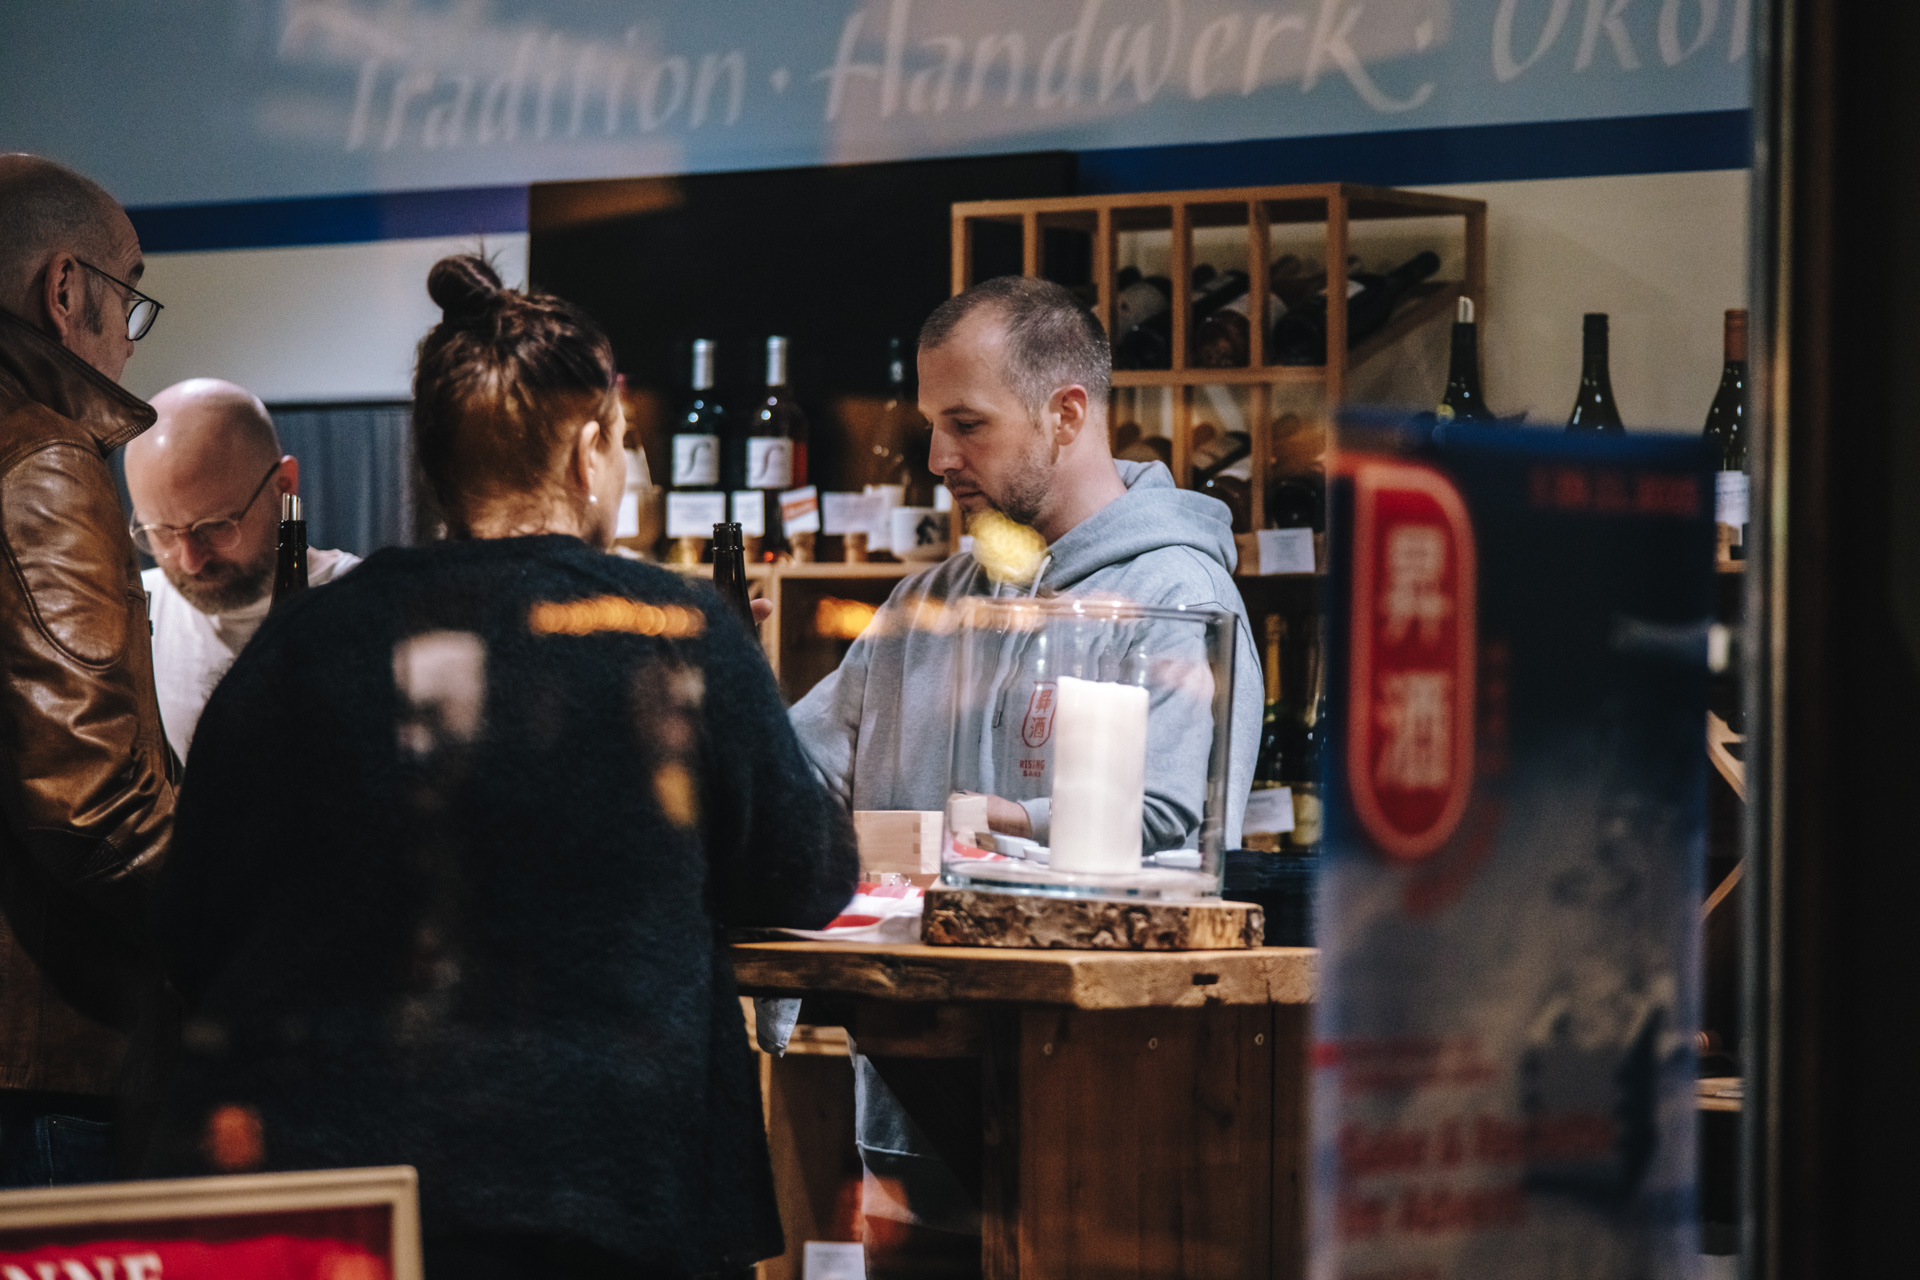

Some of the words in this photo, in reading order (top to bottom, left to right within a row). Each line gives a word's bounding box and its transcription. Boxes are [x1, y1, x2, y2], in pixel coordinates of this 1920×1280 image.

[343, 27, 748, 152] Tradition
[810, 0, 1436, 121] Handwerk
[1019, 759, 1045, 771] RISING
